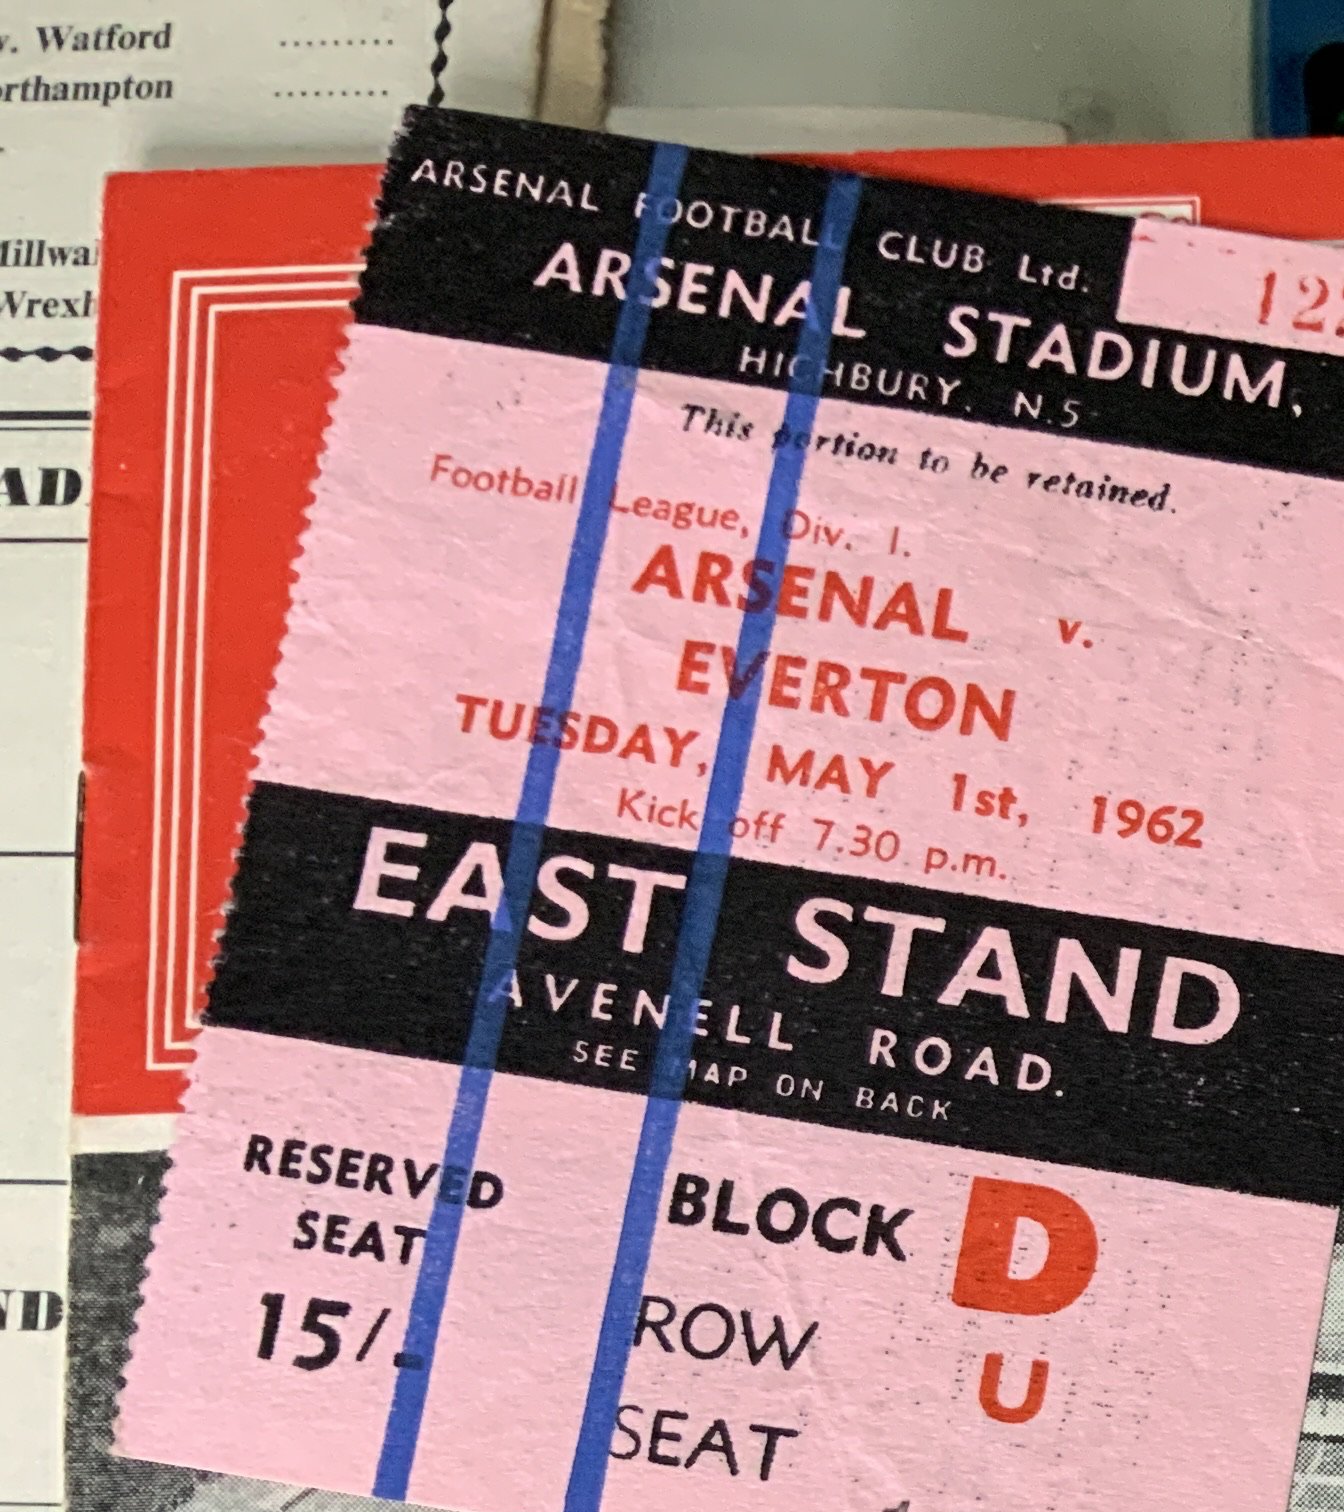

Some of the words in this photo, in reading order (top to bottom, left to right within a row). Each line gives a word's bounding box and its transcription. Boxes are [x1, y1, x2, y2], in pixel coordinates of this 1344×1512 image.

[36, 23, 173, 52] Watford
[0, 75, 174, 107] rthampton
[411, 157, 600, 212] ARSENAL
[634, 192, 843, 248] FOOTBALL
[878, 231, 985, 273] CLUB
[1018, 254, 1089, 293] Ltd.
[534, 242, 867, 340] ARSENAL
[430, 455, 580, 504] Football
[607, 484, 750, 538] League,
[781, 509, 852, 552] Div.
[680, 404, 755, 441] This
[773, 424, 899, 466] portion
[919, 444, 950, 474] to
[970, 451, 1009, 486] be
[1028, 468, 1177, 514] retained.
[631, 544, 969, 643] ARSENAL
[1058, 618, 1094, 649] v.
[675, 640, 1017, 742] EVERTON
[455, 694, 708, 776] TUESDAY,
[766, 745, 895, 800] MAY
[951, 773, 1028, 829] 1st,
[1090, 795, 1205, 848] 1962
[615, 787, 700, 831] Kick
[728, 809, 785, 845] off
[812, 819, 900, 862] 7.30
[924, 848, 1008, 881] p.m.
[352, 826, 687, 955] EAST
[786, 897, 1241, 1046] STAND
[492, 969, 794, 1053] AVENELL
[867, 1026, 1064, 1097] ROAD.
[572, 1040, 639, 1072] SEE
[776, 1073, 825, 1101] ON
[855, 1085, 953, 1121] BACK
[243, 1133, 505, 1210] RESERVED
[292, 1209, 428, 1266] SEAT
[667, 1172, 916, 1263] BLOCK
[952, 1176, 1100, 1316] D
[256, 1291, 424, 1373] 15/-
[631, 1295, 820, 1371] ROW
[978, 1352, 1049, 1424] U
[607, 1404, 800, 1482] SEAT
